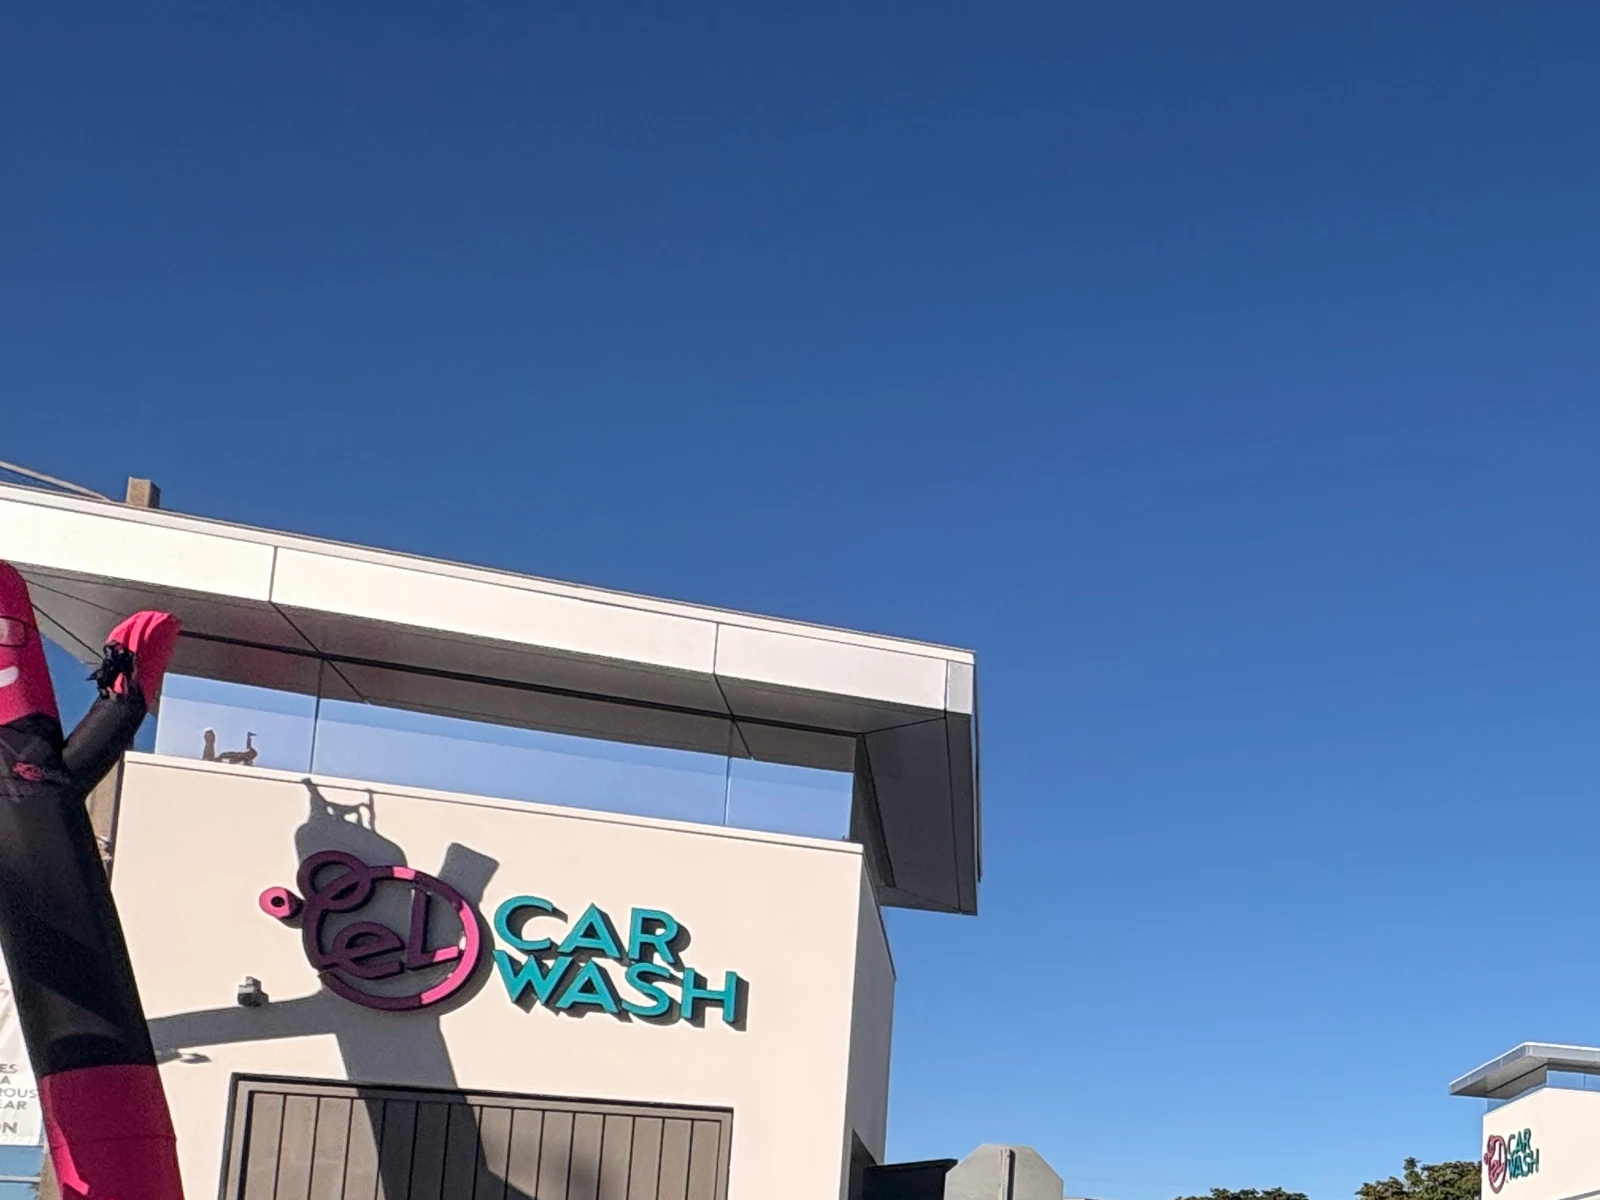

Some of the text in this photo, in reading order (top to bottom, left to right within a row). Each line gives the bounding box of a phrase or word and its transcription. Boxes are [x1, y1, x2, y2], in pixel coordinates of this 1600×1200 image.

[493, 895, 677, 964] CAR
[491, 949, 738, 1024] WASH
[0, 1075, 11, 1085] A
[1507, 1127, 1532, 1157] CAR
[1507, 1148, 1540, 1181] WASH
